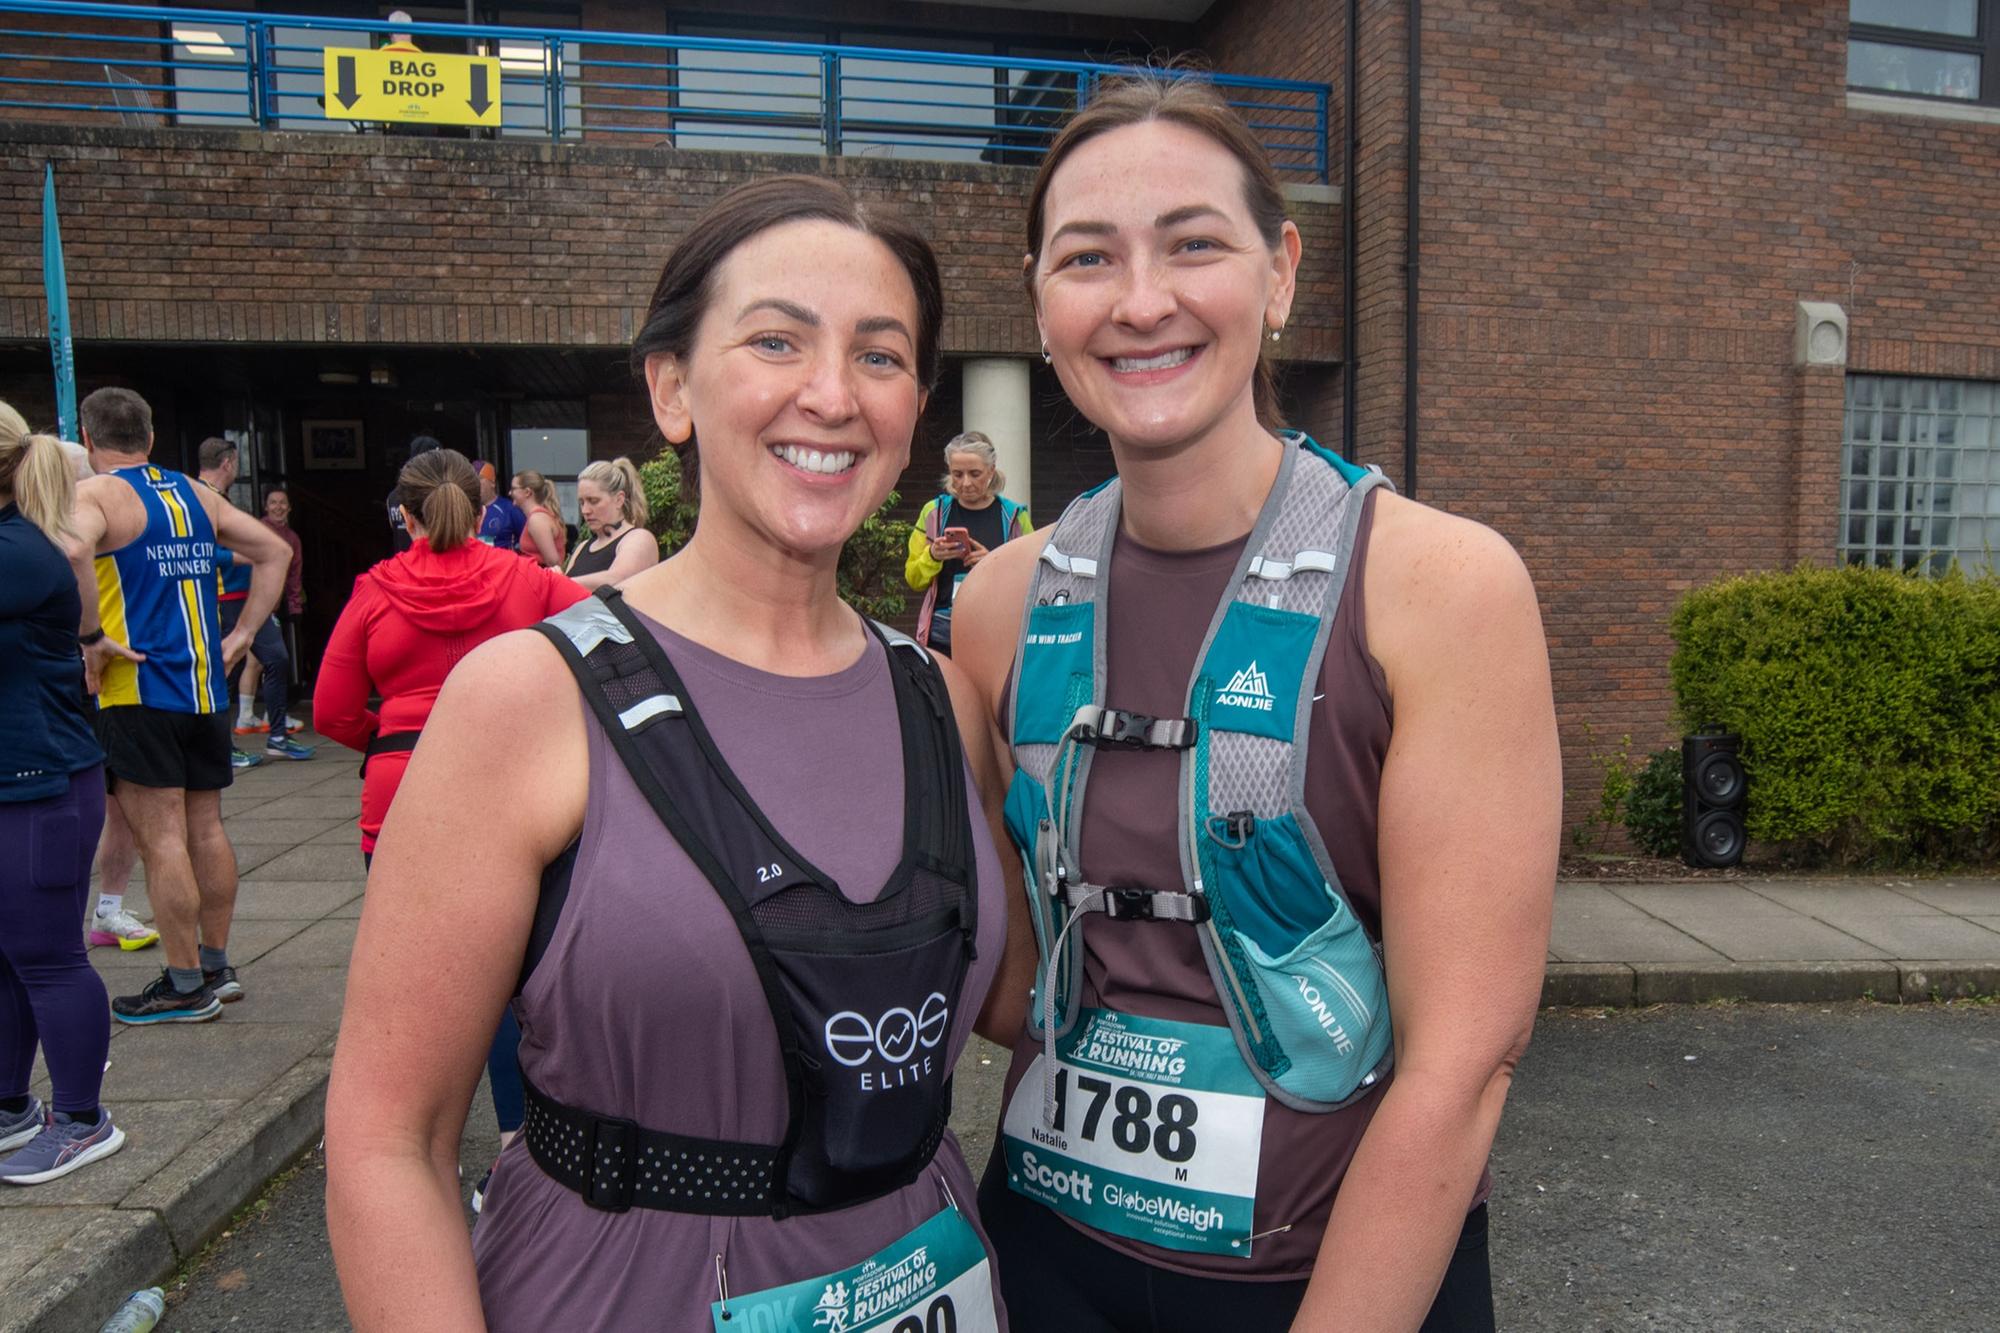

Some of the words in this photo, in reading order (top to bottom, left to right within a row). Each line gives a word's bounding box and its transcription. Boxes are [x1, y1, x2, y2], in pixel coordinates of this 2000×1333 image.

[390, 60, 436, 77] BAG
[382, 80, 444, 97] DROP
[146, 543, 190, 560] NEWRY
[192, 542, 214, 557] CITY
[158, 559, 211, 577] RUNNERS
[1038, 634, 1056, 645] WIND
[1215, 693, 1274, 712] AONIJIE
[756, 863, 783, 883] 2.0
[825, 991, 948, 1067] eos
[1291, 975, 1354, 1056] AONIJIE
[1093, 1029, 1153, 1052] FESTIVAL
[1157, 1040, 1182, 1056] OF
[1087, 1042, 1186, 1076] RUNNING
[860, 1056, 932, 1091] ELITE
[1053, 1067, 1199, 1164] 1788
[1031, 1127, 1068, 1151] Natalie
[1022, 1151, 1093, 1205] Scott
[1174, 1167, 1188, 1182] M
[1103, 1183, 1224, 1232] GlobeWeigh
[1186, 1233, 1208, 1243] service
[855, 1262, 912, 1303] FESTIVAL
[913, 1249, 927, 1270] OF
[853, 1262, 937, 1323] RUNNING
[731, 1295, 800, 1333] 10K
